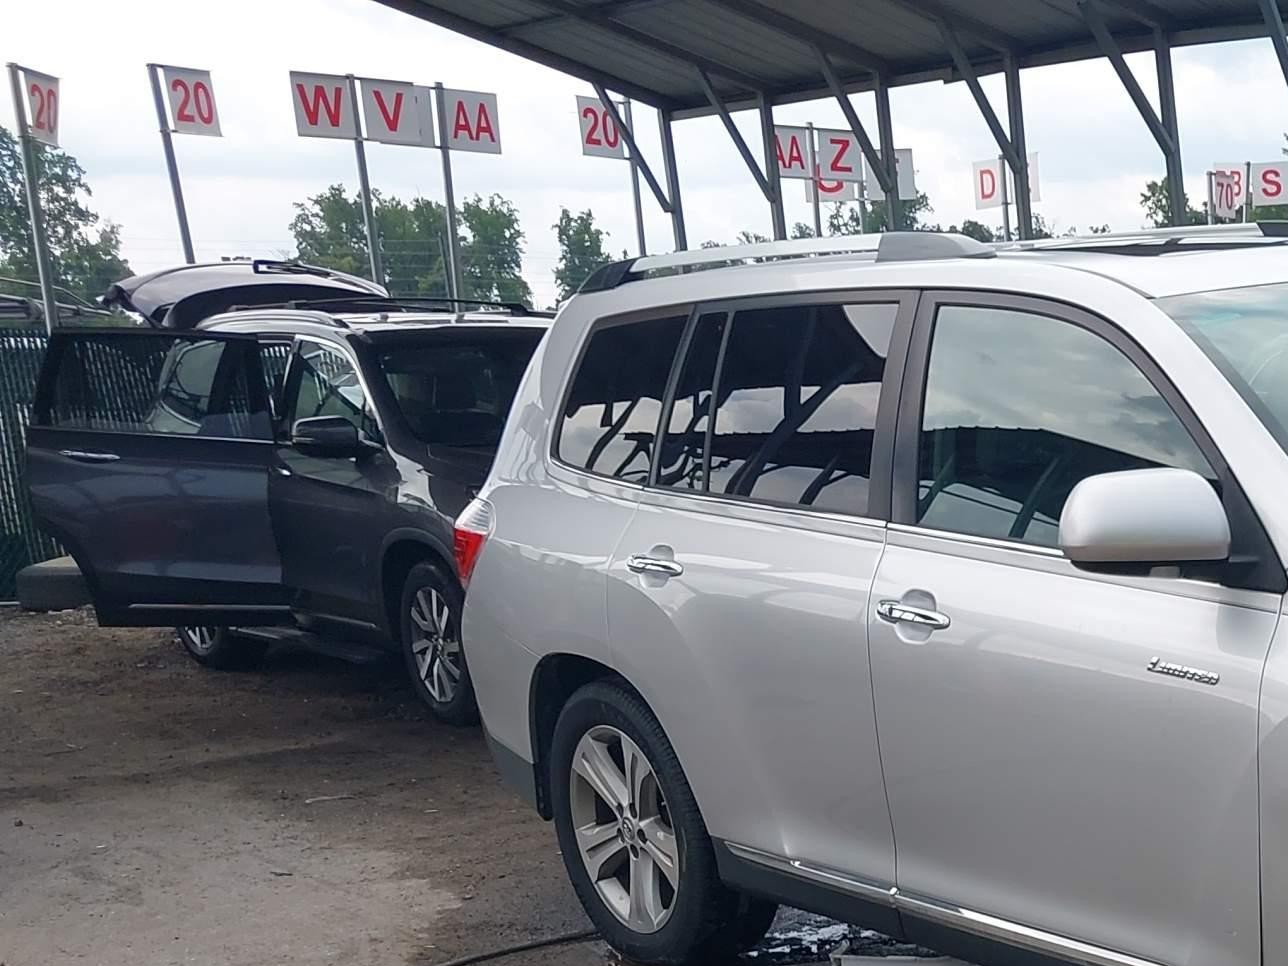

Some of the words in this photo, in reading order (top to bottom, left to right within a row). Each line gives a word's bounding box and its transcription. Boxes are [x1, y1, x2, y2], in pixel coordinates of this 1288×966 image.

[30, 82, 58, 135] 20
[171, 78, 214, 126] 20
[296, 83, 342, 127] W
[372, 89, 404, 133] V
[453, 99, 496, 143] AA
[582, 107, 620, 150] 20
[830, 138, 853, 173] Z
[979, 168, 996, 200] D
[1216, 182, 1234, 210] 70
[1261, 169, 1282, 197] S
